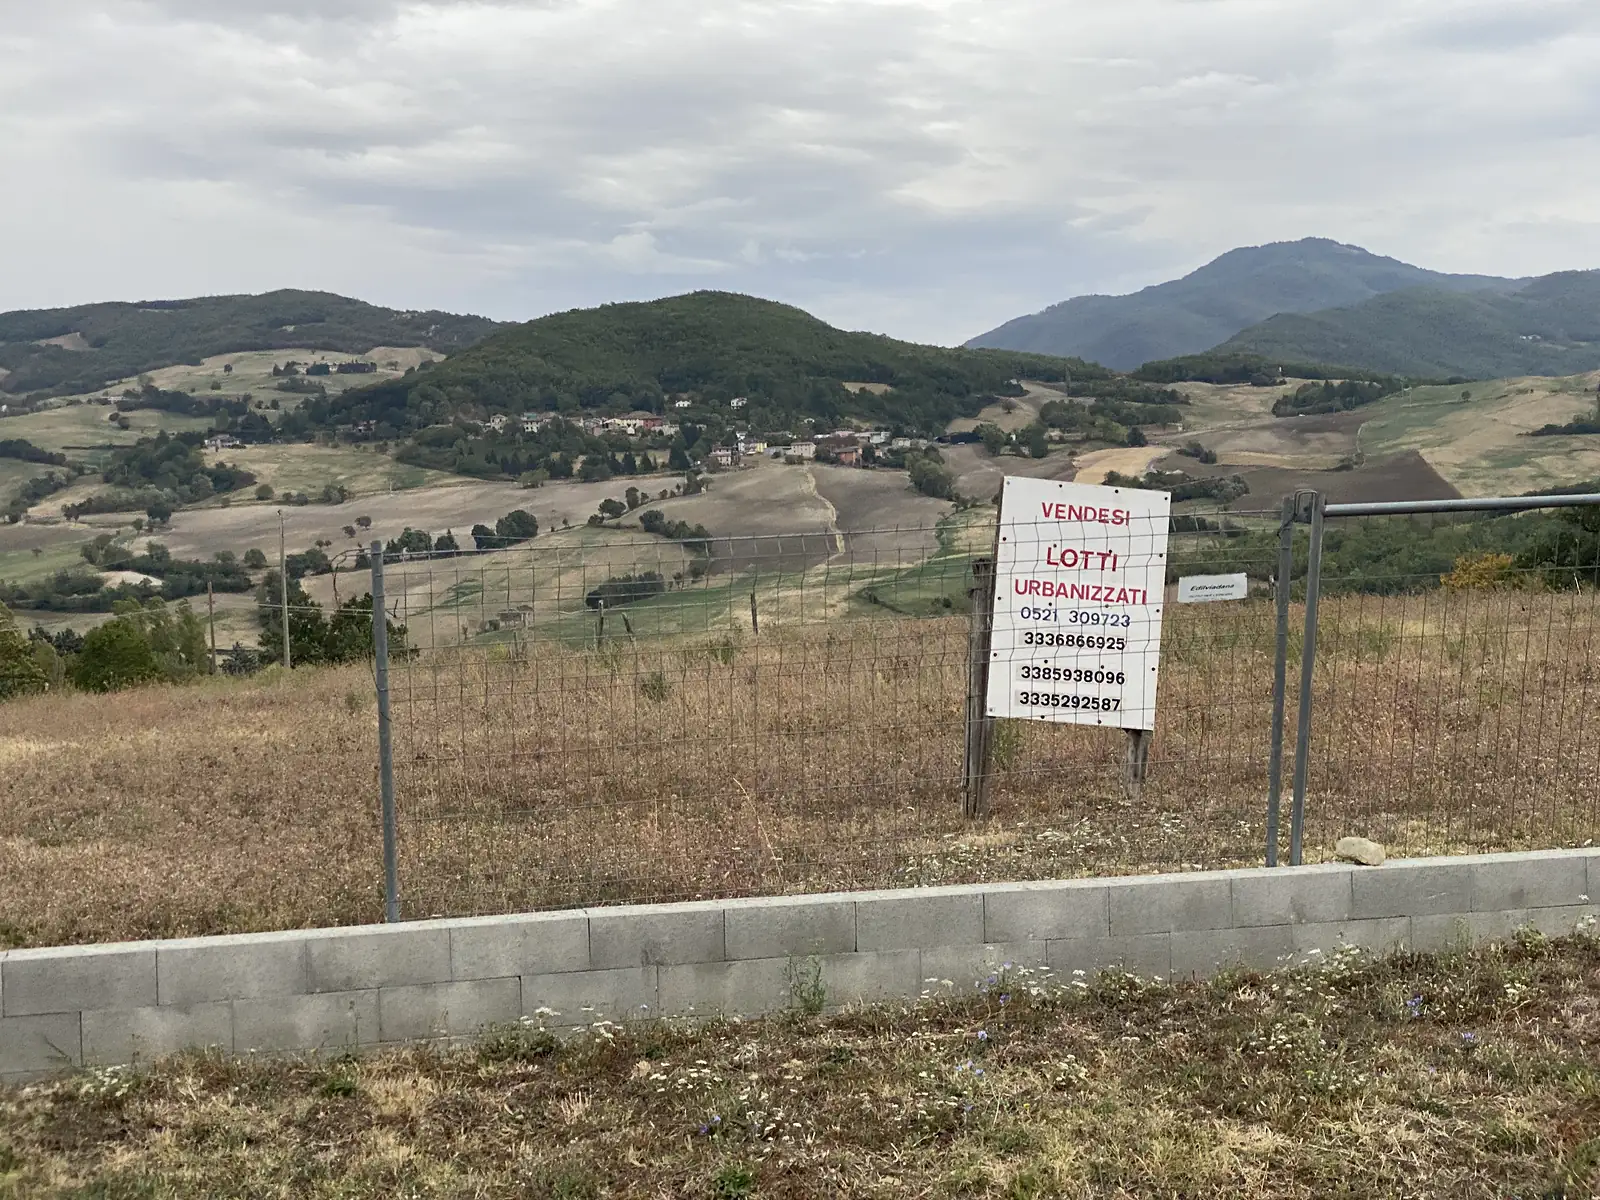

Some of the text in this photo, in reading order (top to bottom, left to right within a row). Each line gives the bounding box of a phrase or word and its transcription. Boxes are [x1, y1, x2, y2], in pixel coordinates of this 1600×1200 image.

[1041, 502, 1130, 526] VENDESI
[1046, 547, 1118, 572] LOTTI
[1014, 579, 1147, 605] URBANIZZATI
[1020, 606, 1131, 628] 0521 309723
[1024, 631, 1126, 650] 3336866925
[1021, 666, 1125, 685] 3385938096
[1019, 691, 1121, 711] 3335292587
